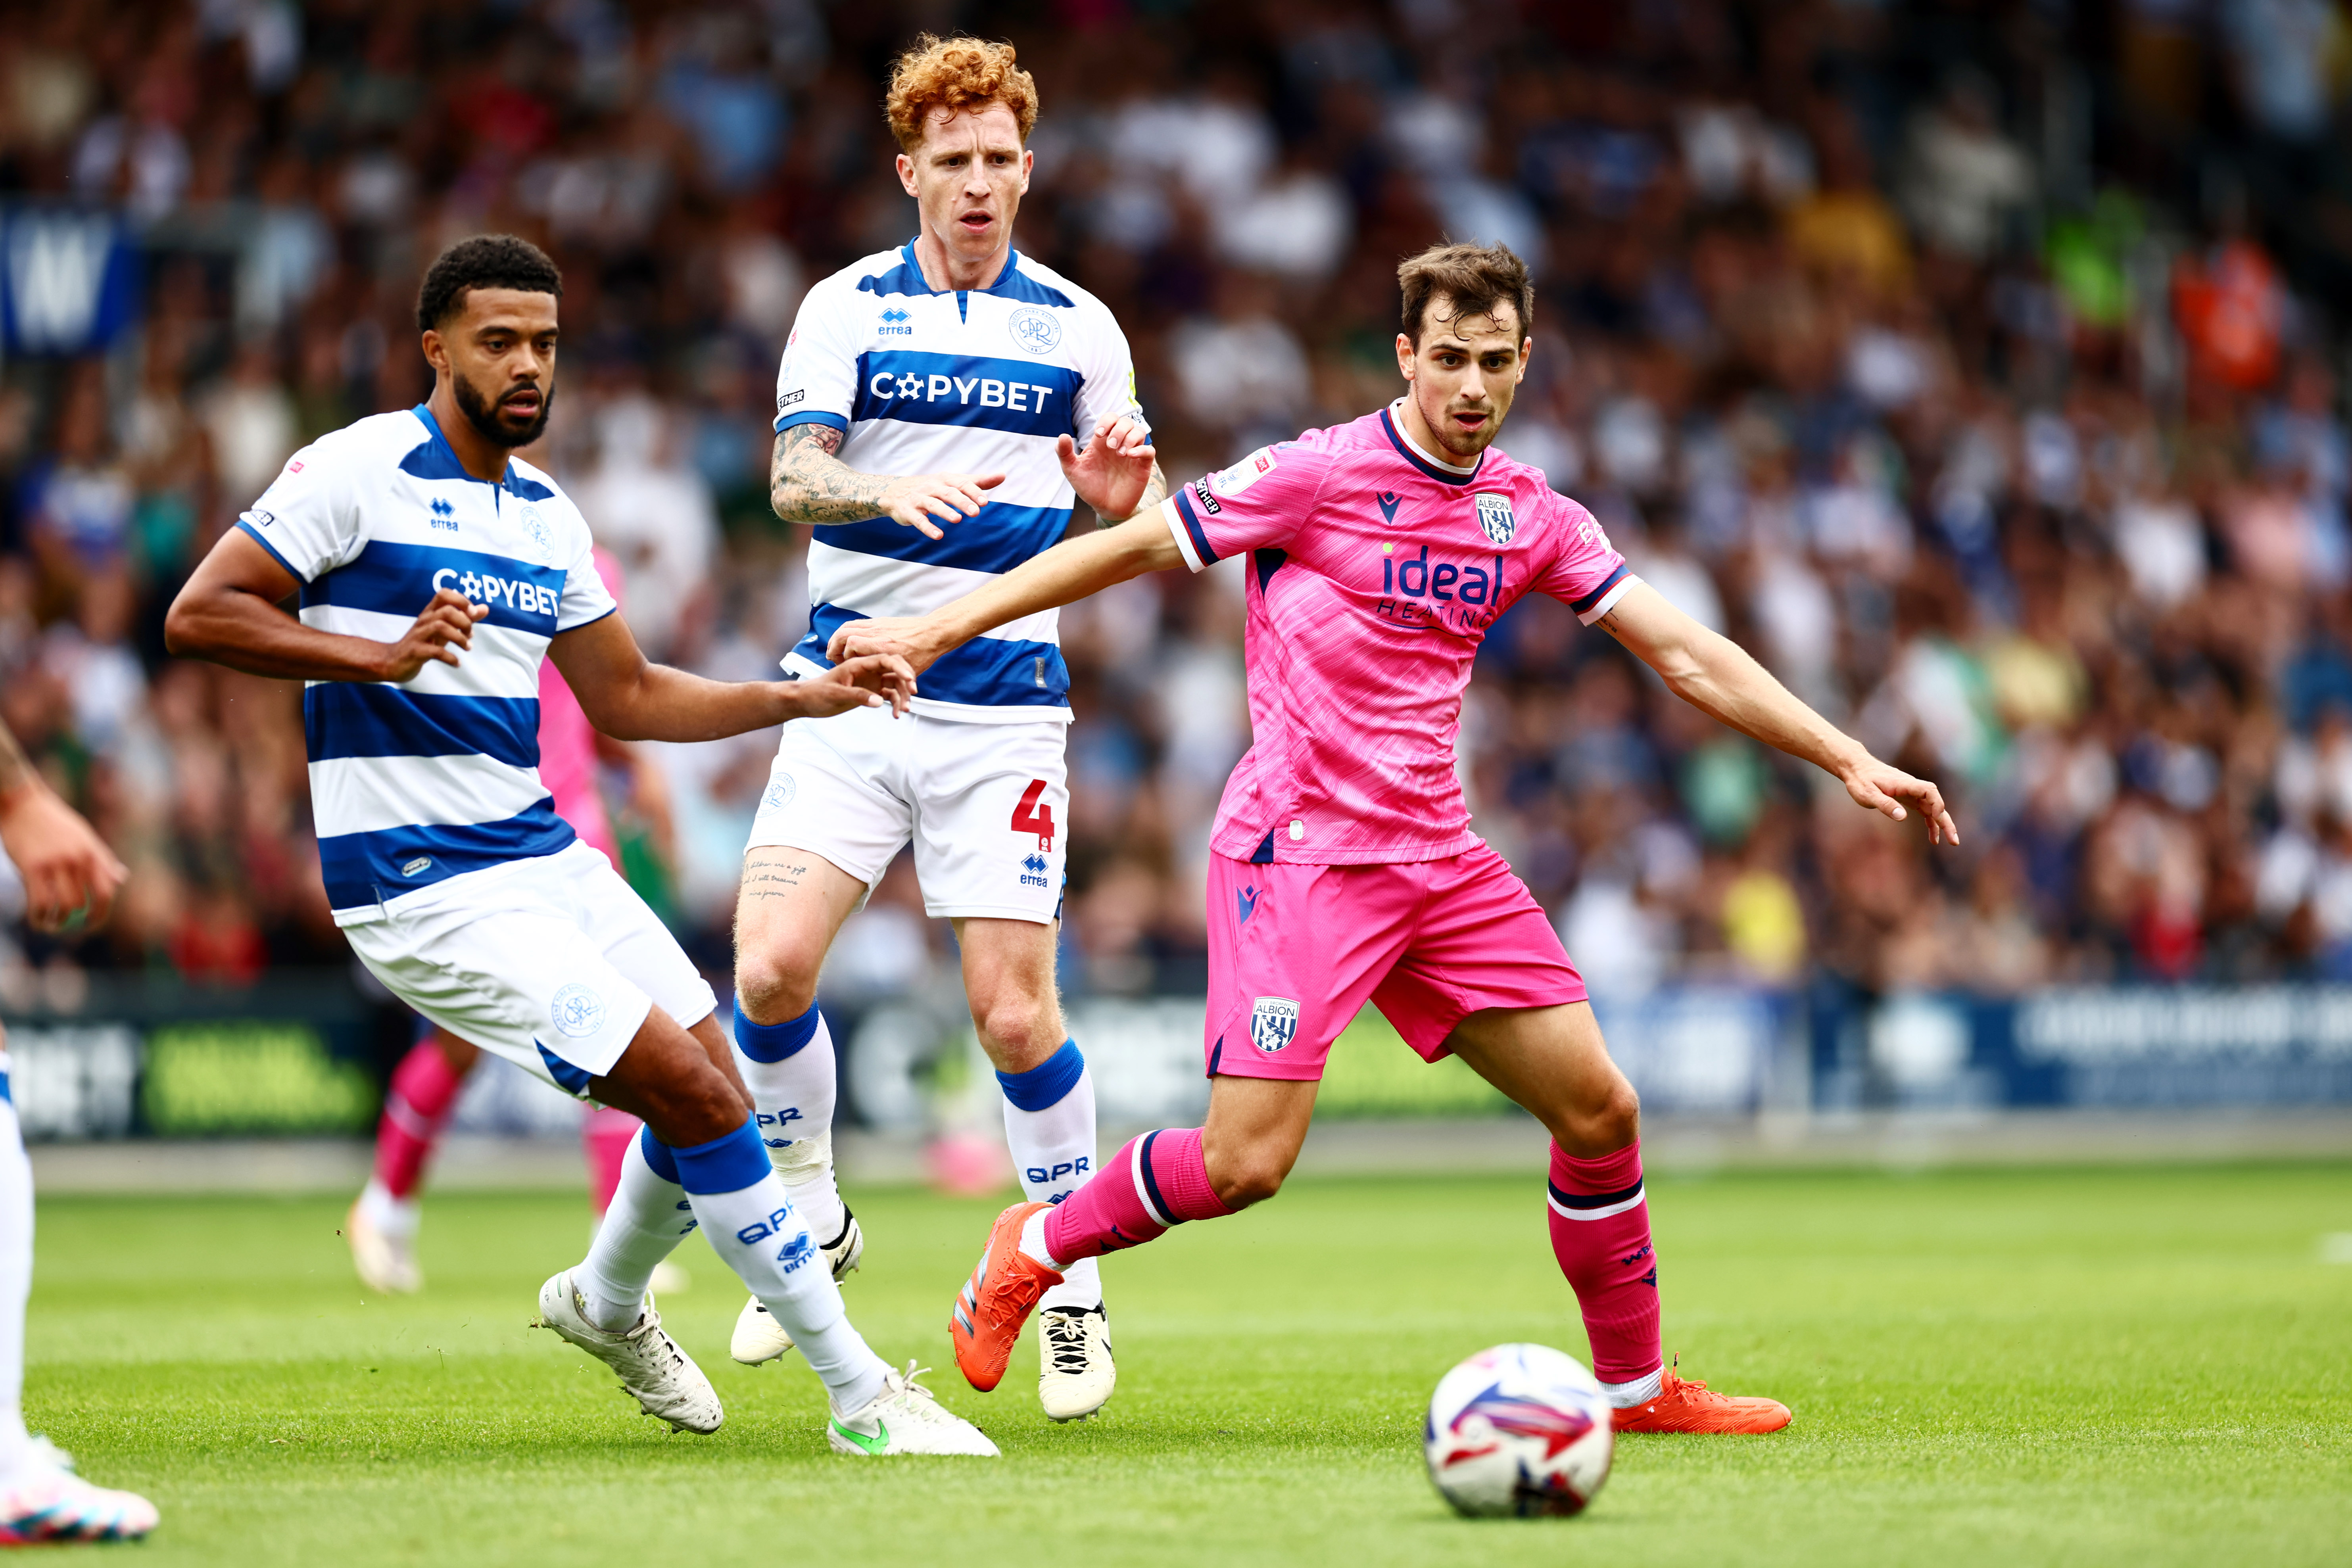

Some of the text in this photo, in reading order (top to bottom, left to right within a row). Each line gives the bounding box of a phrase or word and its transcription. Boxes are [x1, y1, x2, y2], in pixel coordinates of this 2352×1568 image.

[878, 326, 912, 335] errea
[1257, 456, 1267, 471] bet
[1218, 477, 1227, 488] EFL
[1478, 499, 1508, 510] ALBION
[431, 519, 458, 532] errea
[1383, 542, 1503, 607] ideal
[1011, 779, 1054, 853] 4
[791, 866, 807, 875] gift
[771, 875, 798, 885] treasure
[1020, 874, 1048, 888] errea
[761, 889, 785, 900] forever
[1256, 1005, 1295, 1017] ALBION
[1027, 1156, 1089, 1183] QPR
